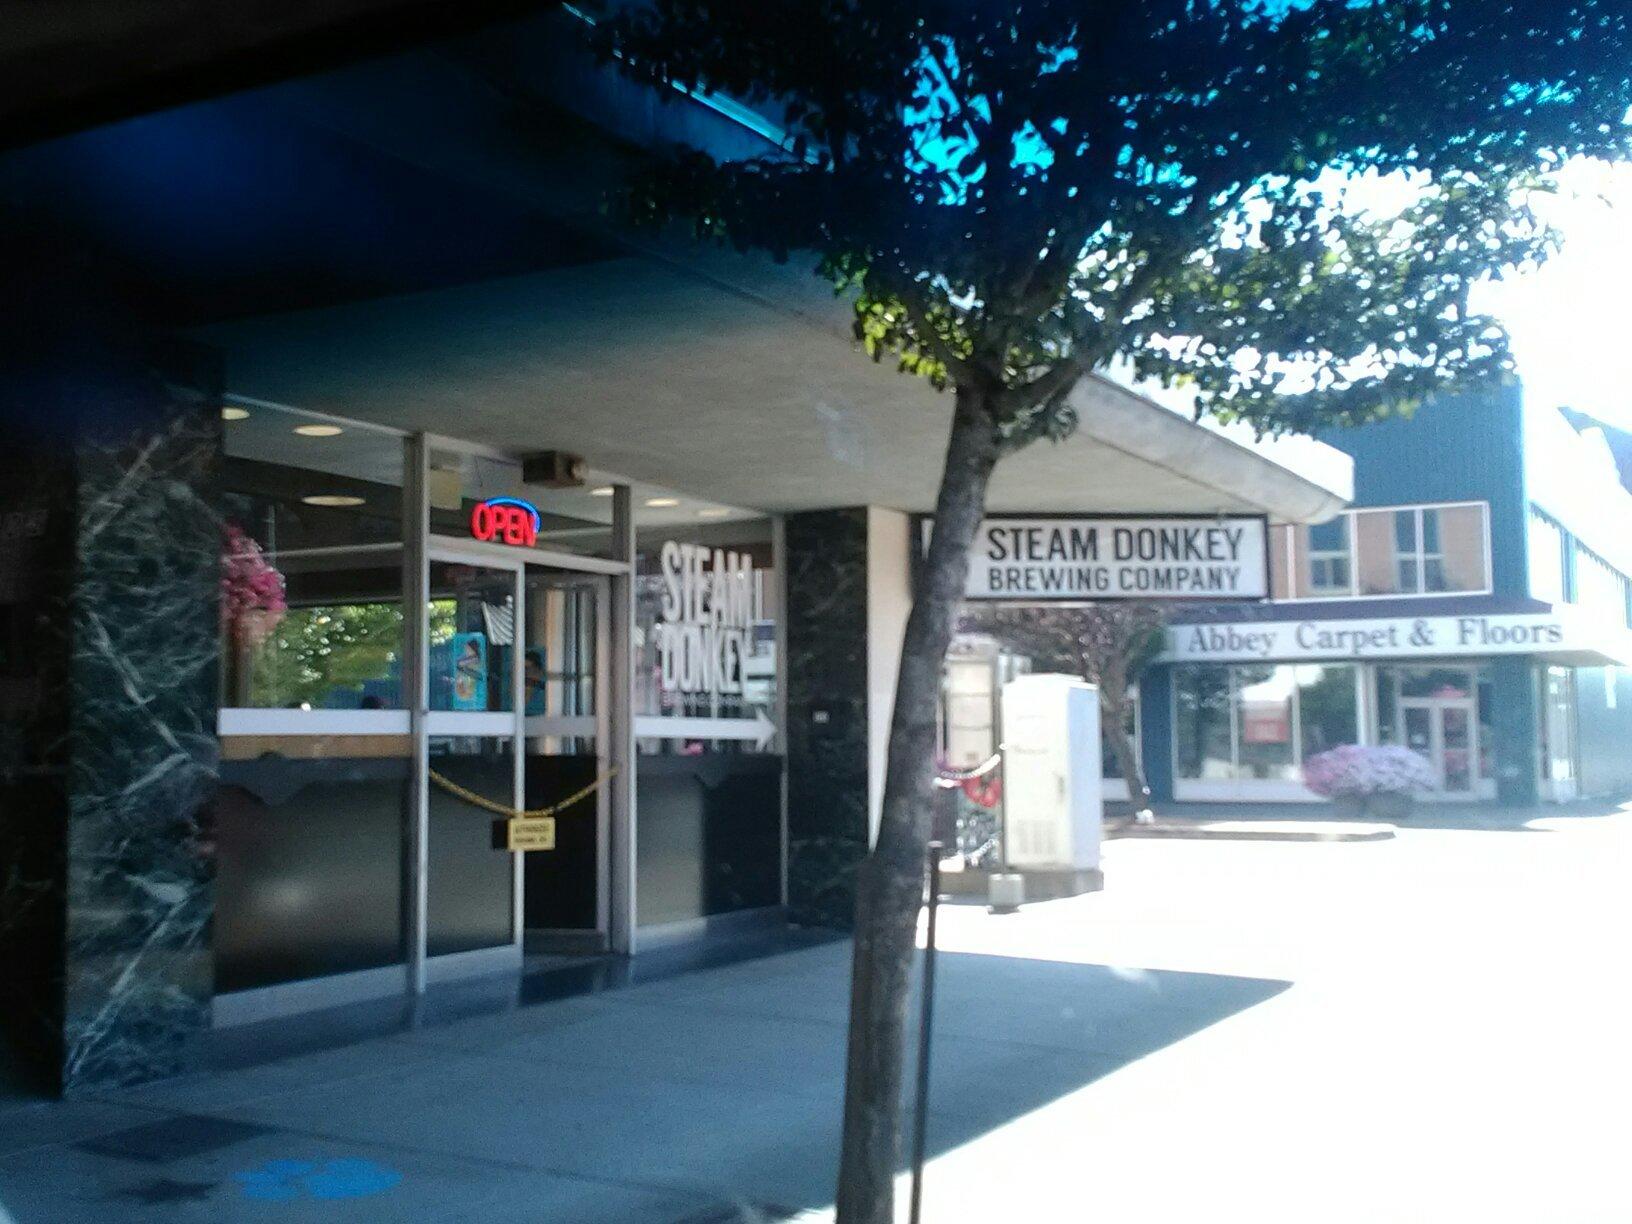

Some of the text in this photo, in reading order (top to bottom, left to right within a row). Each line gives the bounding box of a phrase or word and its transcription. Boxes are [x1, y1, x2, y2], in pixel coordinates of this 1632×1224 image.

[471, 502, 537, 547] OPEN
[988, 527, 1243, 561] STEAM DONKEY
[661, 540, 753, 626] STEAM
[989, 567, 1241, 593] BREWING COMPANY
[1187, 617, 1563, 656] Abbey Carpet & Floors
